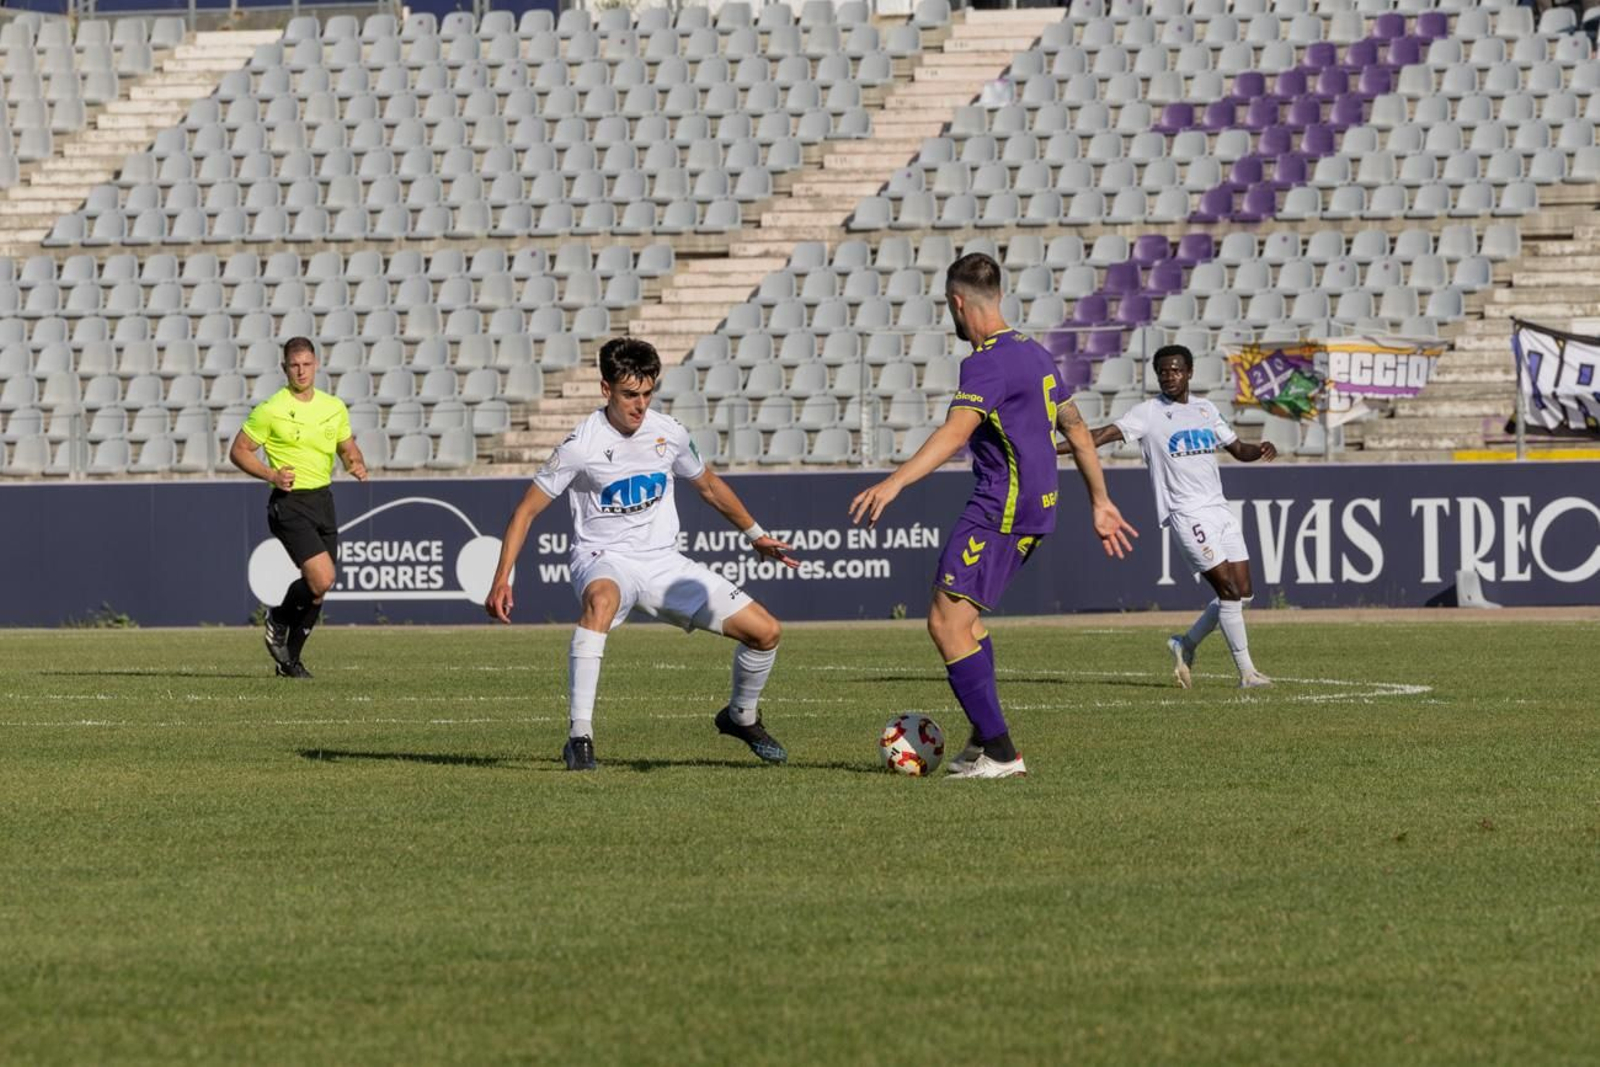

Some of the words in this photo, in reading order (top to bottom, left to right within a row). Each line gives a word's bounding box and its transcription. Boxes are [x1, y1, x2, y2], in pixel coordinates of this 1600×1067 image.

[693, 528, 841, 551] AUTOIZADO
[847, 528, 876, 549] EN
[882, 523, 940, 549] JAÉN
[1192, 523, 1207, 544] 5
[336, 541, 443, 562] ESGUACE
[331, 565, 444, 590] .TORRES
